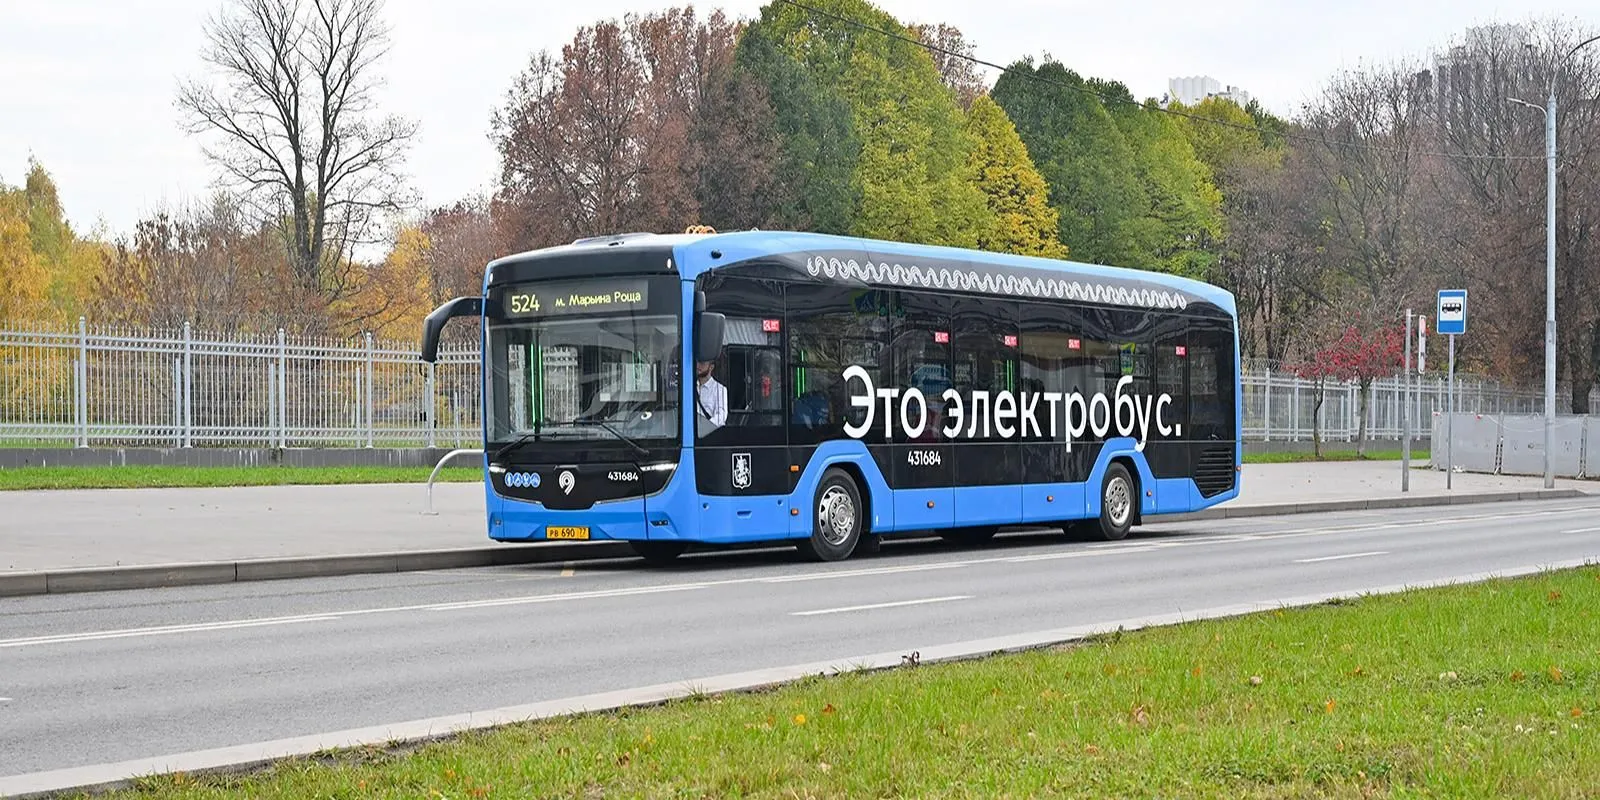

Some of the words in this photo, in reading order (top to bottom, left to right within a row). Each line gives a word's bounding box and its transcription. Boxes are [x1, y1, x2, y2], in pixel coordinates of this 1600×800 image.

[511, 294, 540, 313] 524
[568, 294, 611, 307] Марьина
[614, 291, 642, 303] Роща
[842, 365, 928, 439] Это
[942, 375, 1182, 453] электробус.
[908, 450, 941, 466] 431684
[607, 471, 639, 481] 431684
[561, 528, 575, 538] 690
